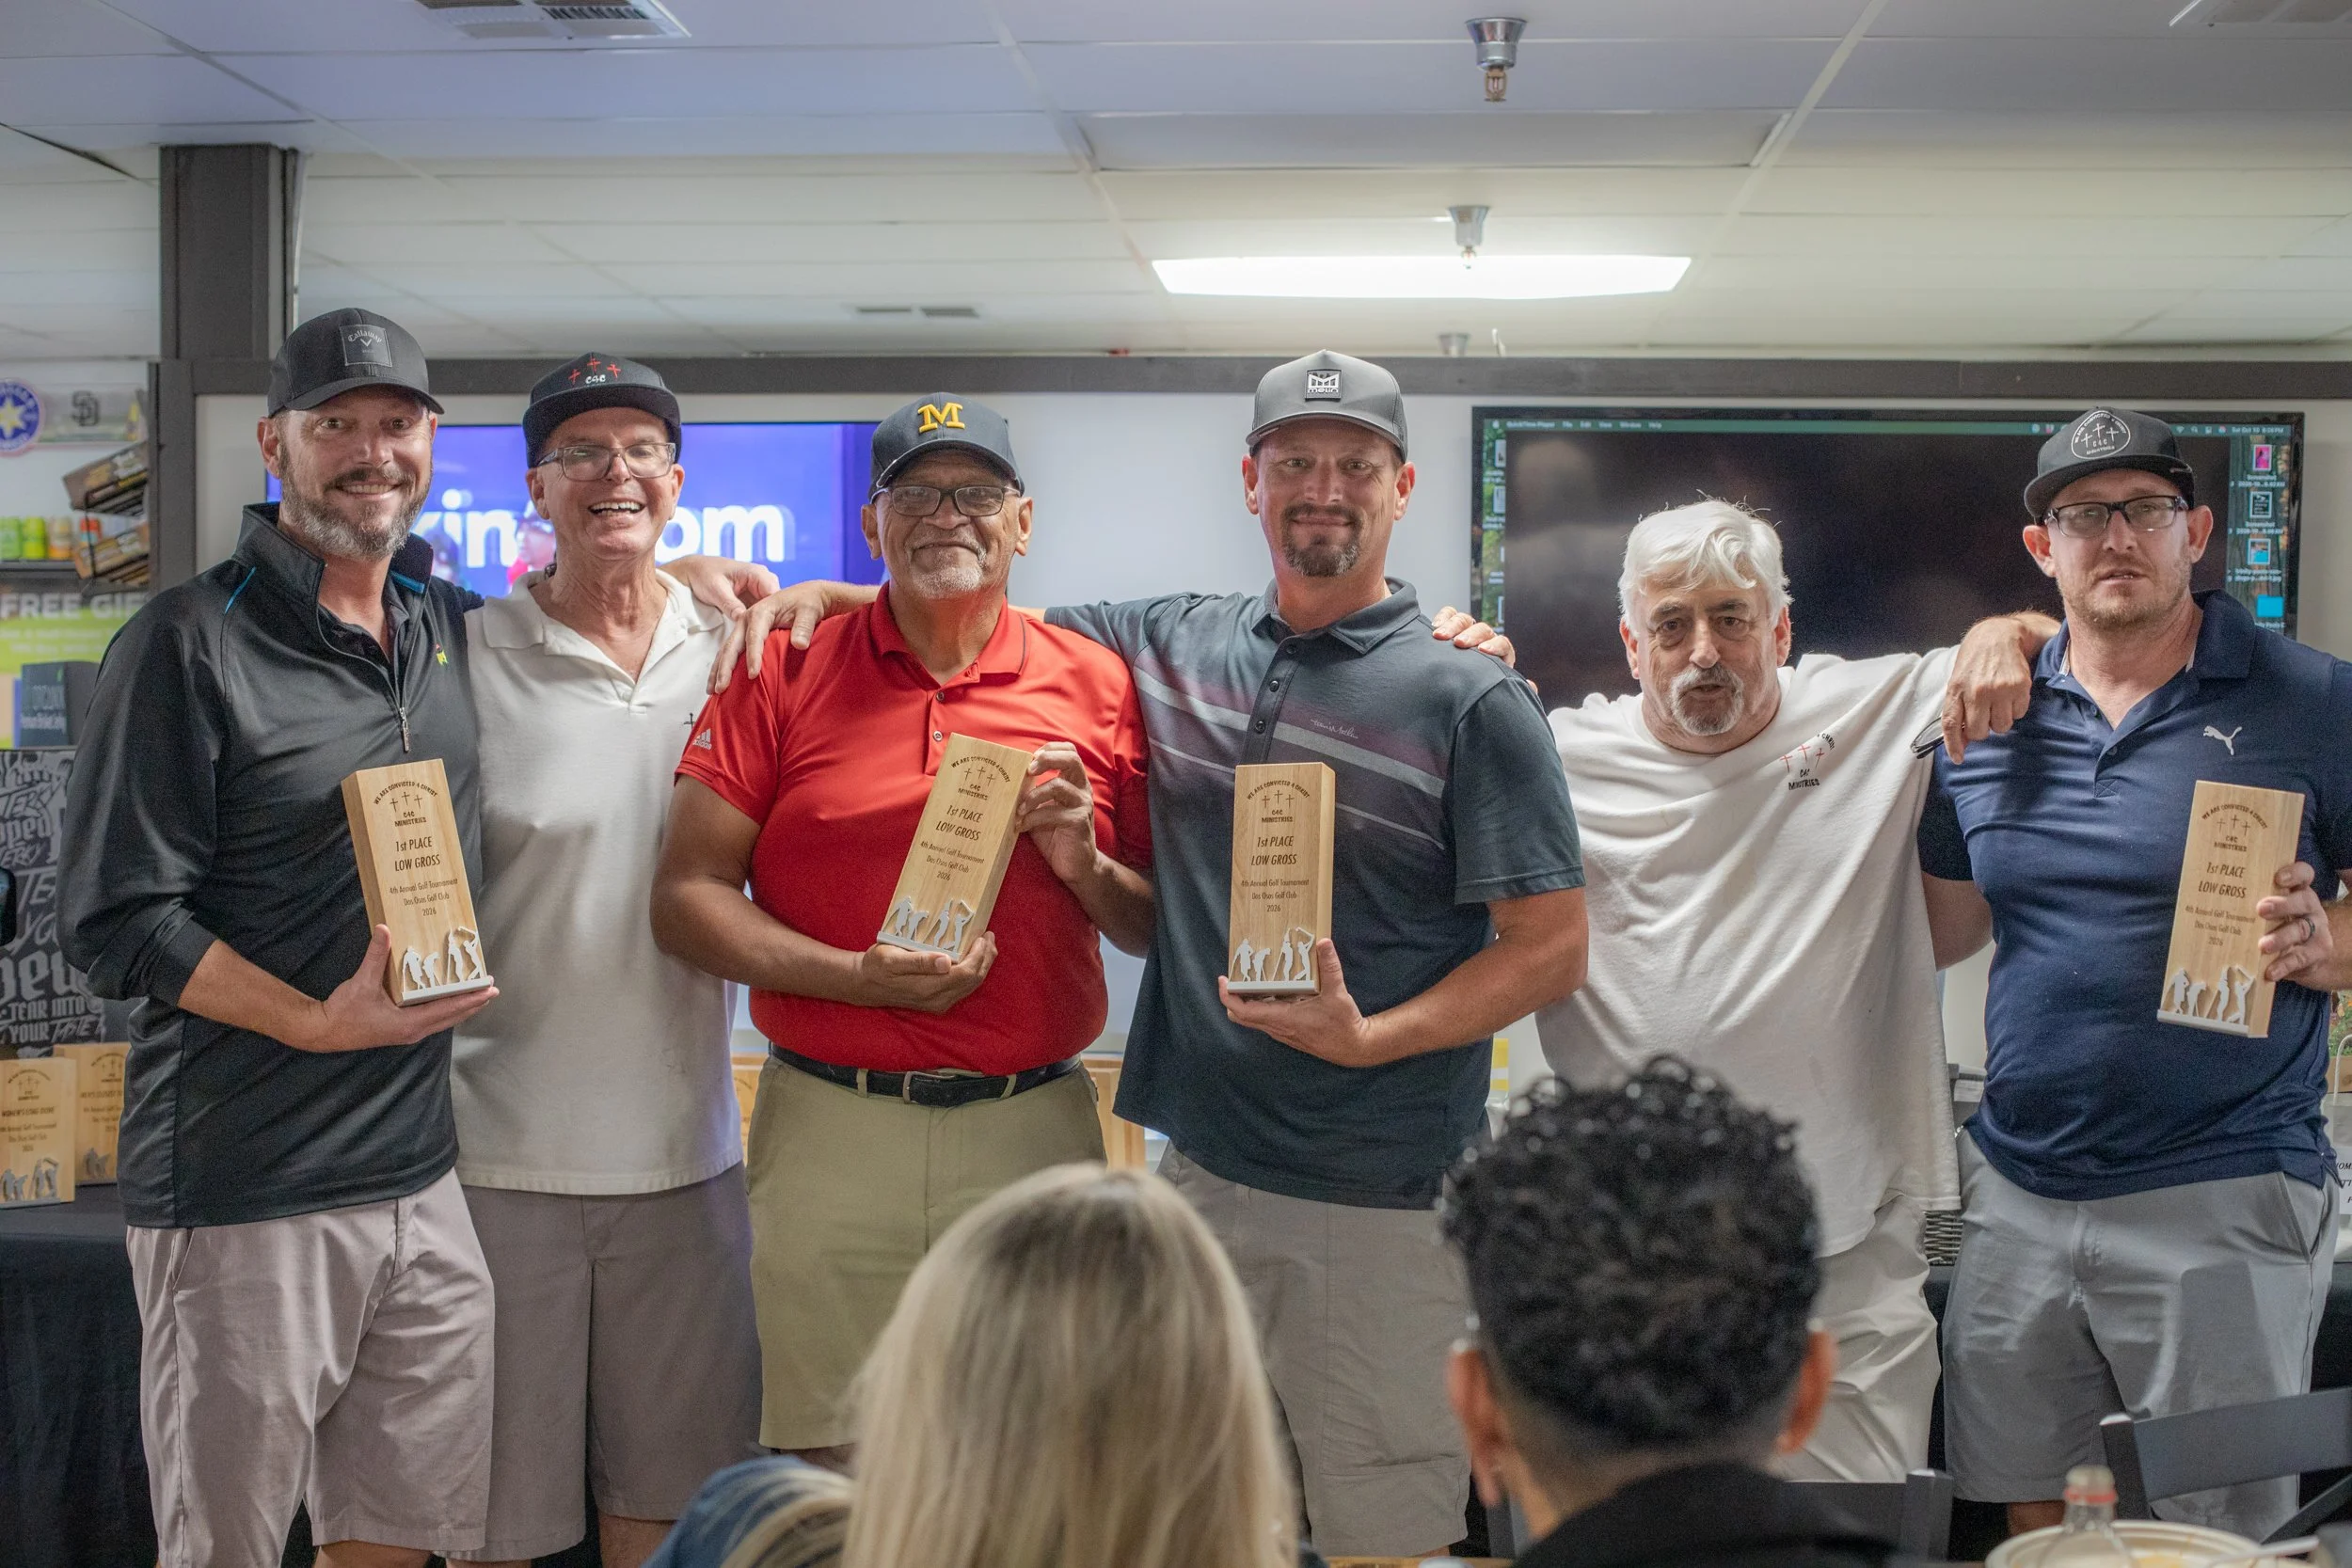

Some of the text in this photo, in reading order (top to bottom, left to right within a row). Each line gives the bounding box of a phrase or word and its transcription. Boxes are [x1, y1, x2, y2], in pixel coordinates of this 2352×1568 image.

[917, 402, 965, 433] M
[0, 593, 149, 620] FREE GIF
[389, 782, 415, 790] CONVICTED
[421, 784, 437, 797] CHRIST
[946, 805, 983, 822] 1st PLACE
[936, 821, 981, 840] LOW GROSS
[396, 836, 432, 851] 1st PLACE
[1258, 836, 1294, 847] 1st PLACE
[395, 854, 440, 871] LOW GROSS
[1251, 854, 1296, 865] LOW GROSS
[2207, 862, 2246, 878] 1st PLACE
[419, 881, 427, 890] Golf
[429, 879, 457, 888] Tournament
[2199, 880, 2247, 898] LOW GROSS
[427, 894, 437, 902] Golf
[8, 1000, 48, 1022] TEAR
[9, 1022, 50, 1044] YOUR
